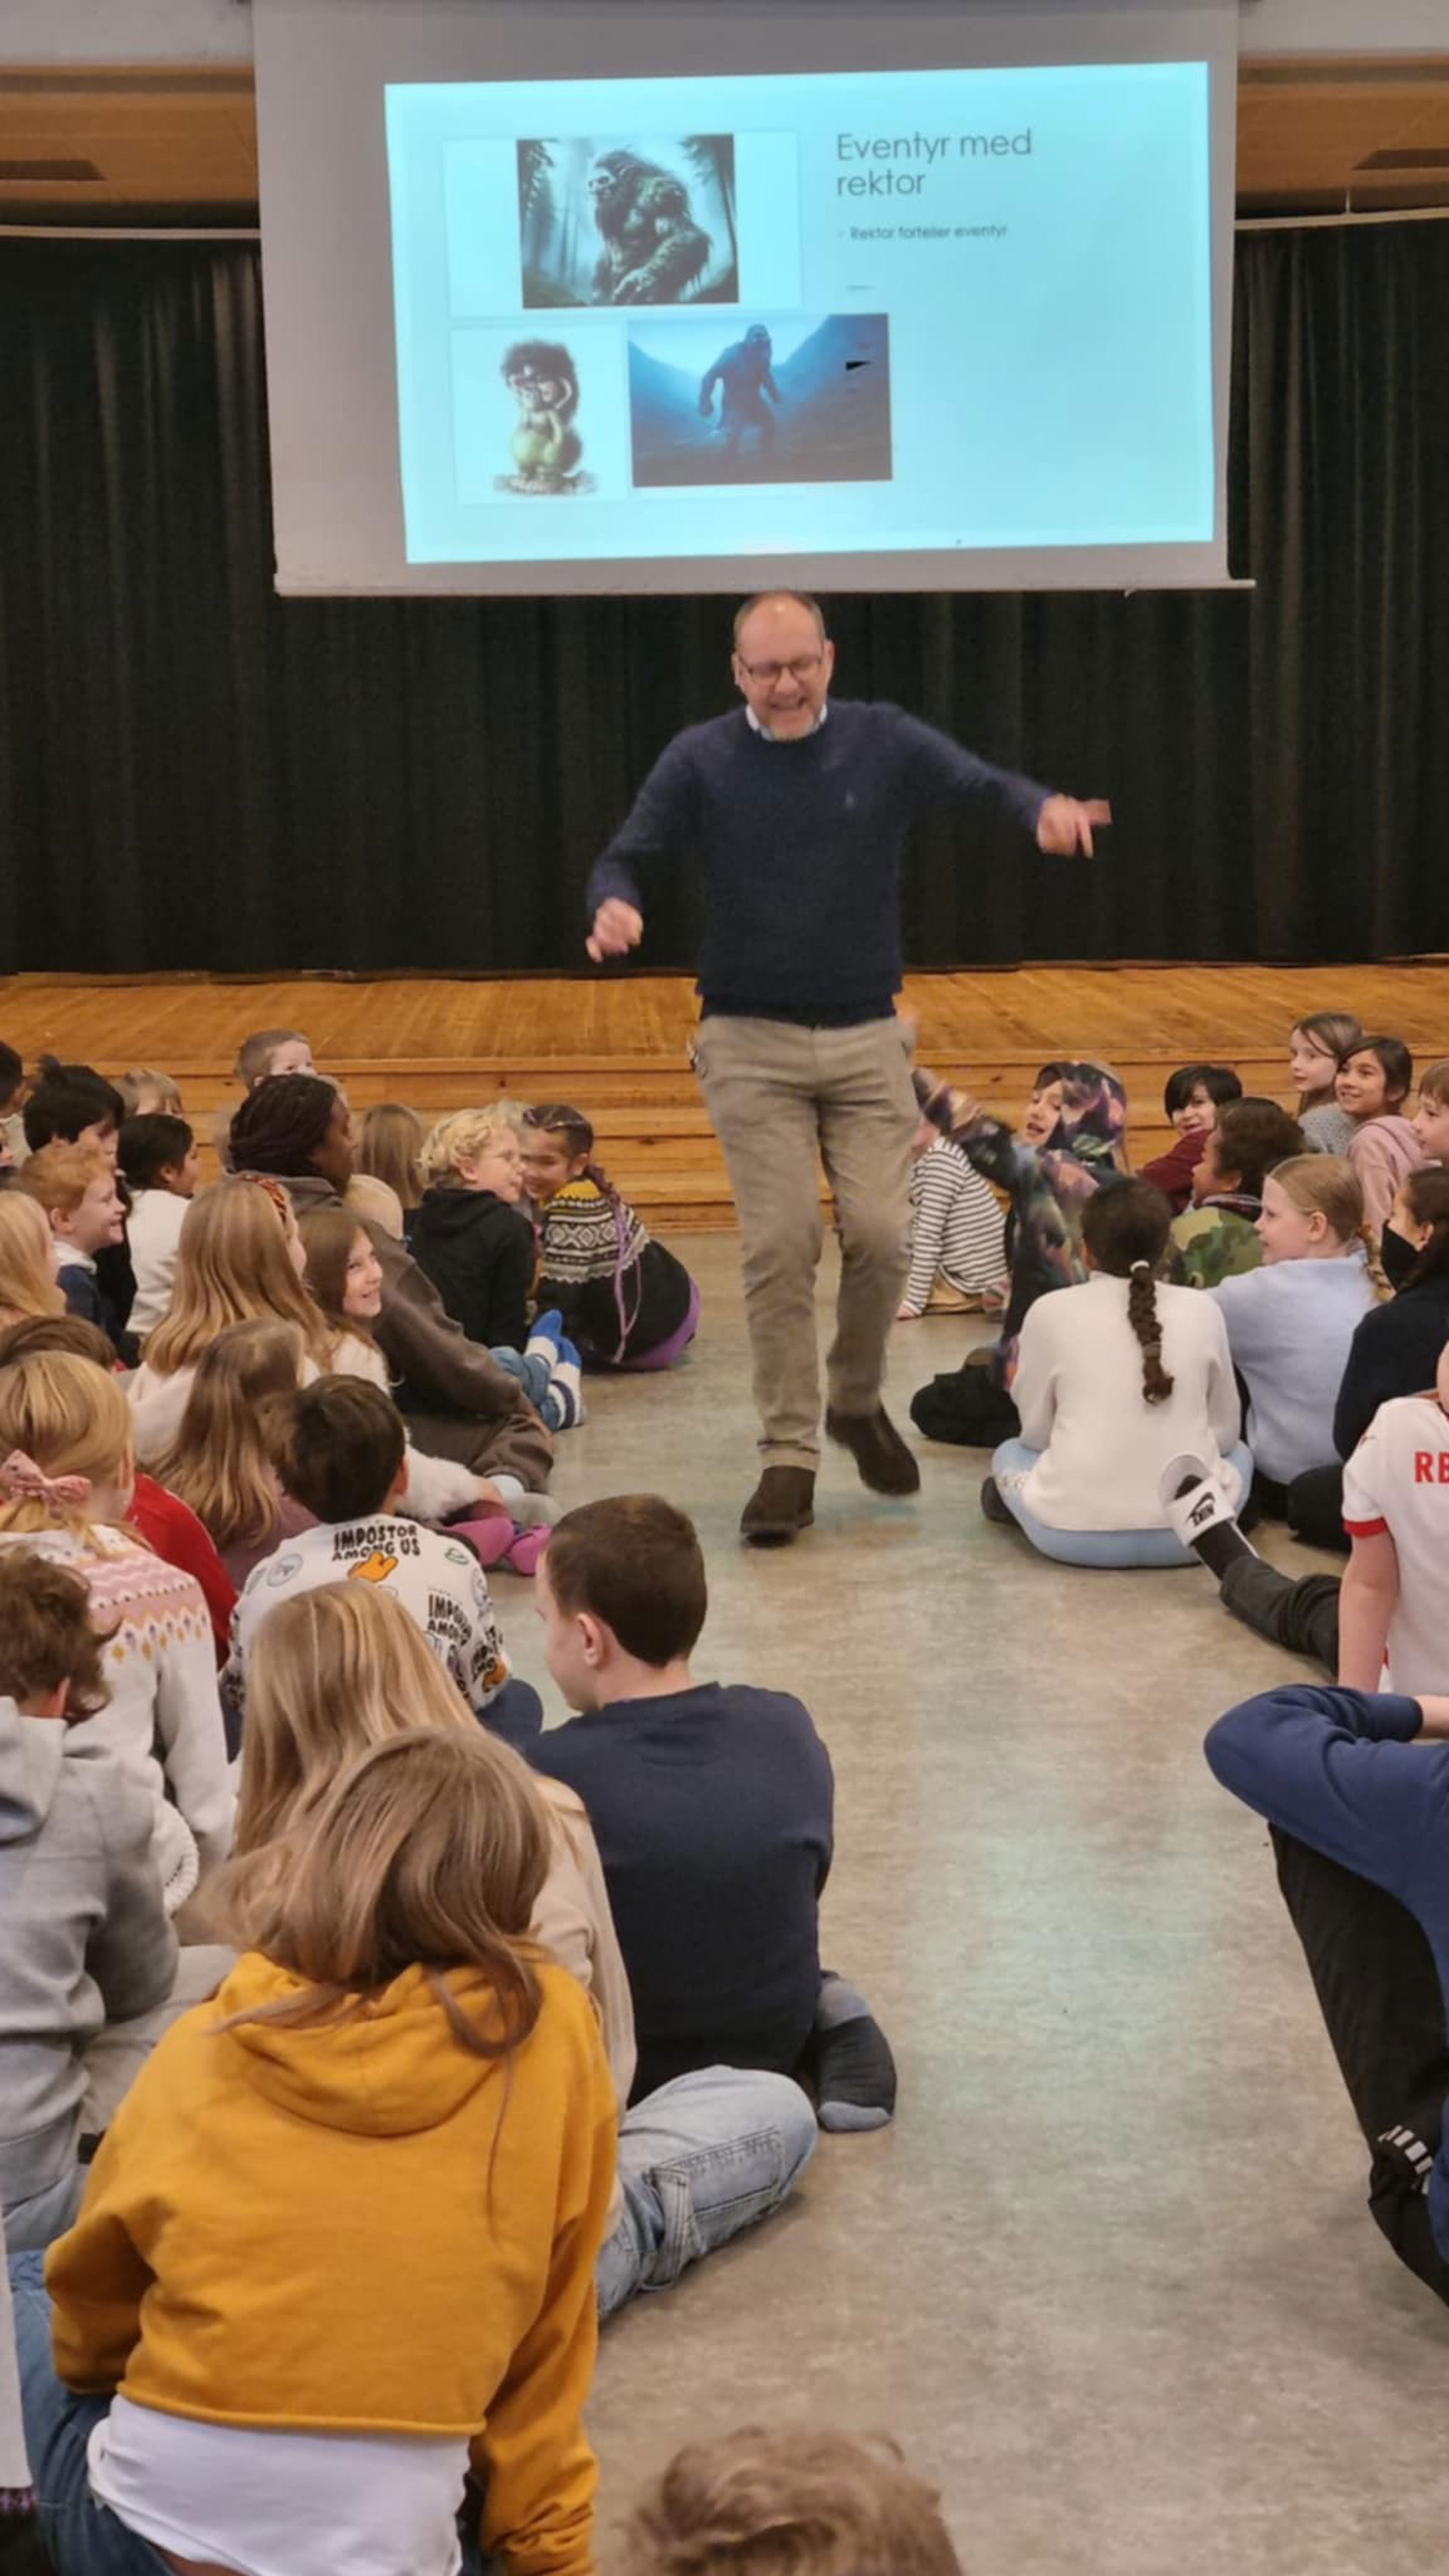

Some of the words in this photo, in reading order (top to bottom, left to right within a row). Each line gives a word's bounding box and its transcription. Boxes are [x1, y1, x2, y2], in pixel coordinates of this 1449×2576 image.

[837, 131, 950, 164] Eventyr
[960, 128, 1032, 156] med
[837, 168, 926, 197] rektor
[850, 225, 895, 240] Rektor
[332, 1541, 395, 1562] AMONG
[400, 1538, 421, 1556] US
[334, 1525, 416, 1551] IMPOSTOR
